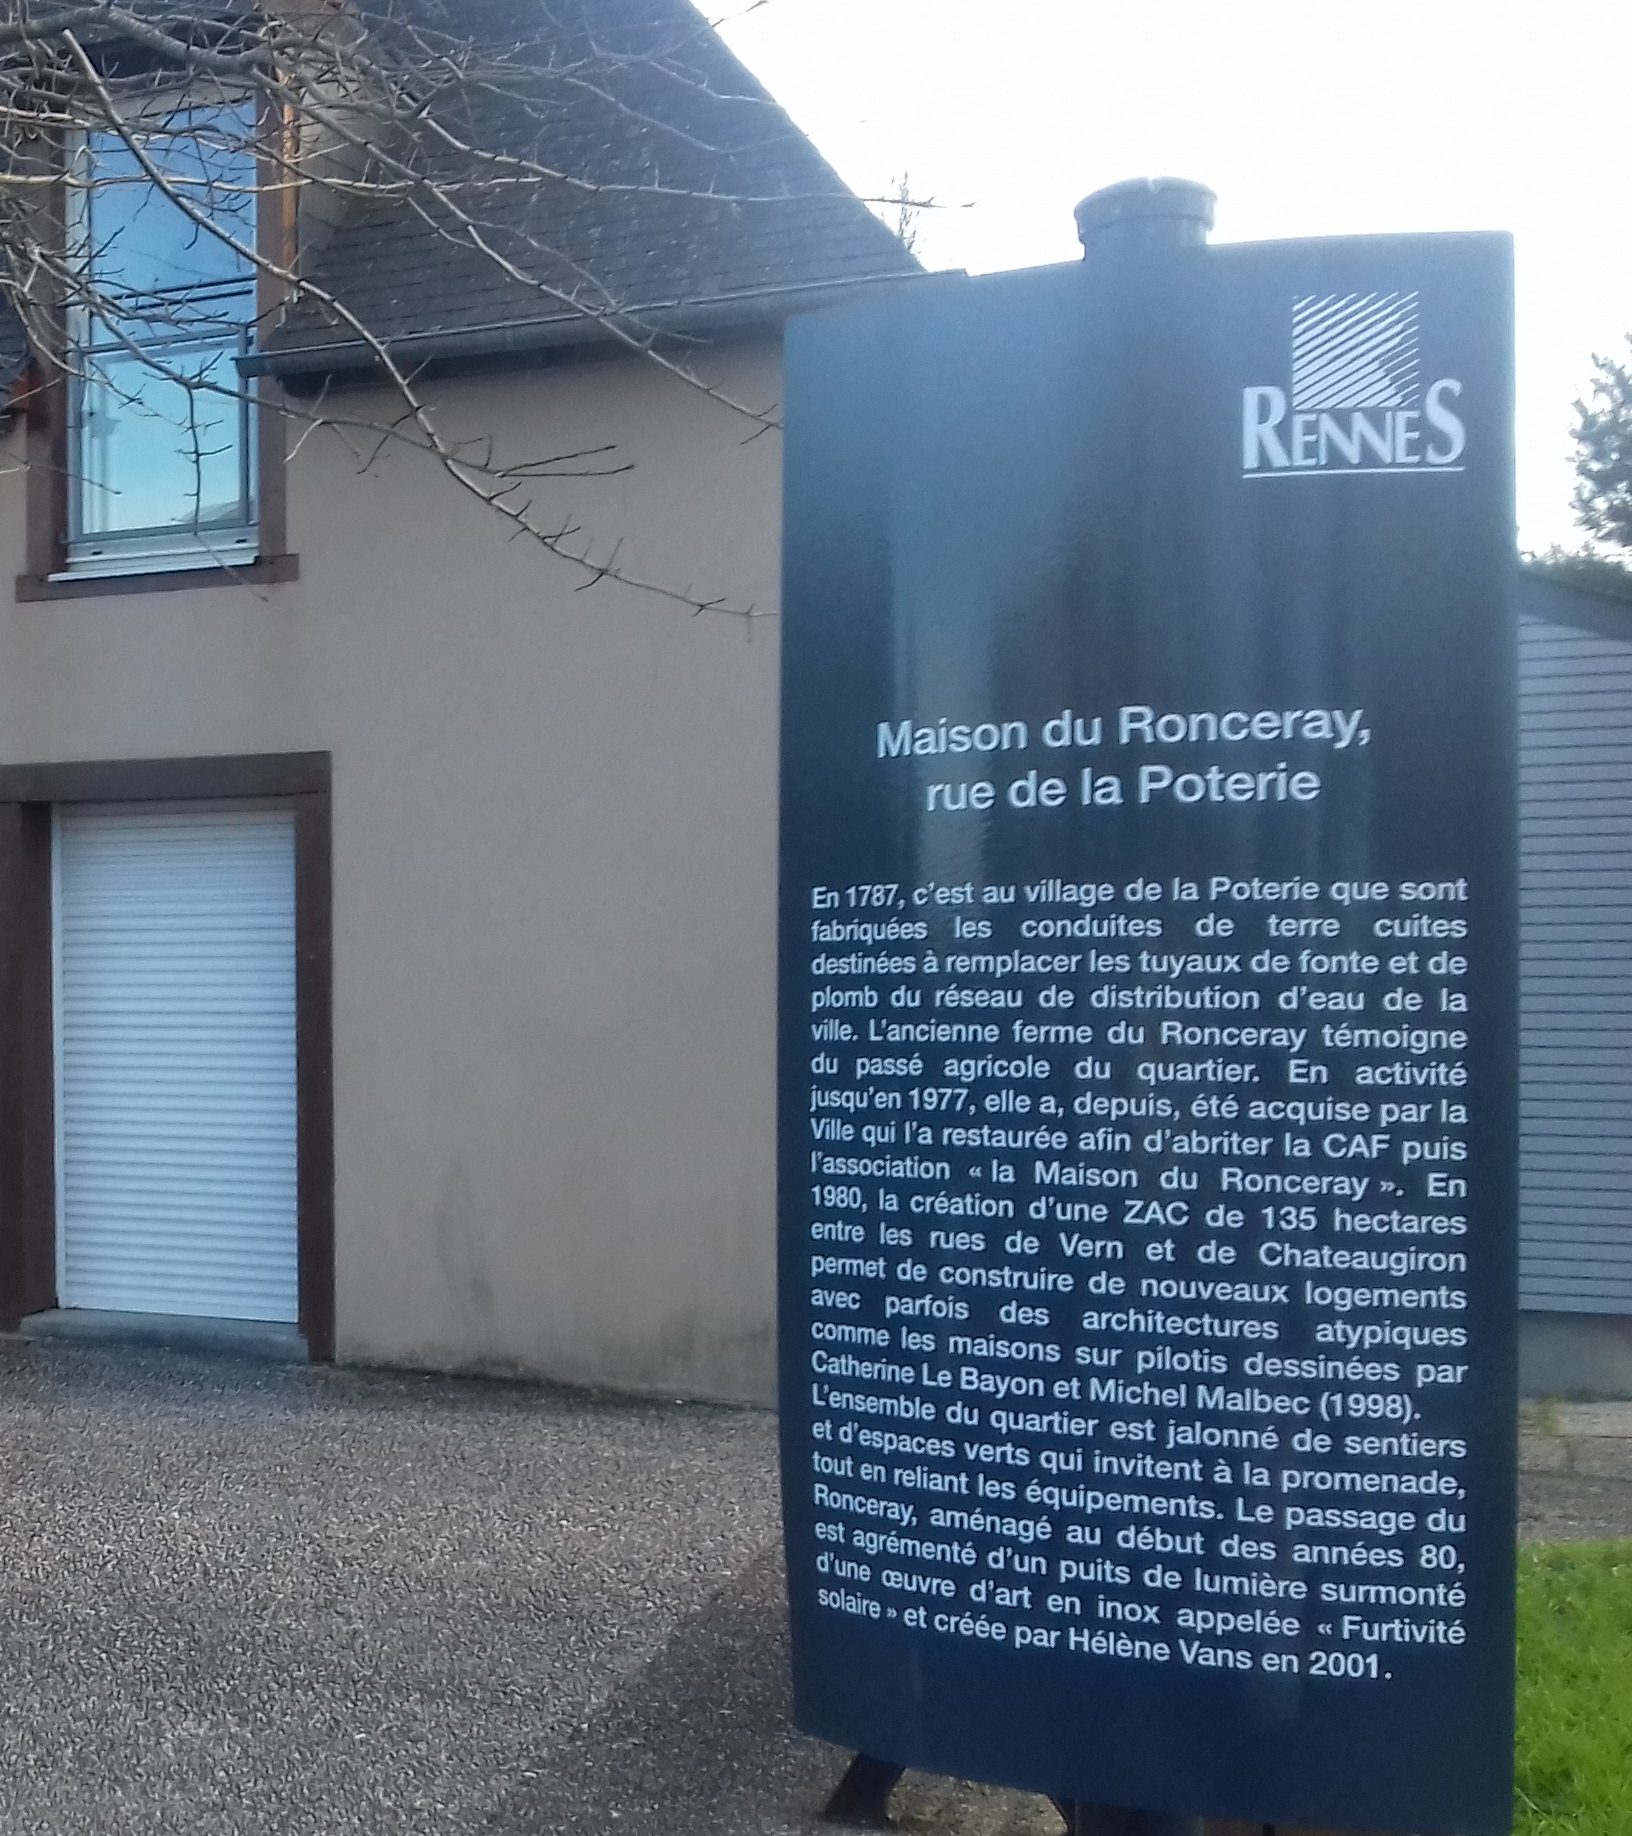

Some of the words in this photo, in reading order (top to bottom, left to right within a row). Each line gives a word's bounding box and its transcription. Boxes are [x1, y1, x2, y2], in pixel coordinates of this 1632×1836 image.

[1242, 379, 1466, 470] RENNES
[878, 718, 1027, 758] Maison
[1042, 709, 1101, 747] du
[1119, 706, 1370, 749] Ronceray,
[927, 782, 995, 811] rue
[1008, 770, 1067, 808] de
[1081, 768, 1124, 805] la
[1139, 762, 1321, 803] Poterie
[812, 886, 839, 909] En
[845, 884, 905, 909] 1787,
[913, 882, 974, 905] c'est
[982, 885, 1015, 904] au
[1023, 879, 1115, 907] village
[1124, 877, 1162, 902] de
[1172, 877, 1199, 901] la
[1209, 876, 1320, 901] Poterie
[1330, 882, 1389, 906] que
[1399, 878, 1468, 901] sont
[811, 917, 928, 945] fabriquées
[955, 916, 992, 938] les
[1020, 913, 1162, 938] conduites
[1195, 913, 1234, 937] de
[1267, 914, 1340, 937] terre
[1373, 913, 1468, 938] cuites
[811, 951, 916, 975] destinées
[923, 950, 939, 973] à
[945, 949, 1082, 978] remplacer
[1089, 949, 1131, 973] les
[1138, 950, 1242, 979] tuyaux
[1250, 949, 1291, 973] de
[1298, 949, 1380, 974] fonte
[1388, 951, 1419, 974] et
[1427, 951, 1468, 975] de
[811, 985, 878, 1012] plomb
[890, 985, 921, 1007] du
[935, 984, 1022, 1008] réseau
[1038, 984, 1074, 1008] de
[1090, 984, 1259, 1009] distribution
[1278, 986, 1364, 1010] d'eau
[1382, 987, 1423, 1011] de
[1440, 987, 1468, 1012] la
[811, 1019, 858, 1041] ville.
[869, 1018, 1000, 1042] L'ancienne
[1012, 1019, 1092, 1044] ferme
[1107, 1021, 1144, 1044] du
[1161, 1021, 1307, 1053] Ronceray
[1321, 1023, 1468, 1054] témoigne
[811, 1051, 838, 1074] du
[856, 1052, 923, 1080] passé
[944, 1054, 1050, 1082] agricole
[1074, 1056, 1110, 1079] du
[1137, 1058, 1259, 1086] quartier.
[1288, 1059, 1328, 1083] En
[1355, 1061, 1467, 1086] activité
[810, 1084, 901, 1113] jusqu'en
[909, 1087, 975, 1115] 1977,
[984, 1089, 1031, 1113] elle
[1039, 1096, 1064, 1118] a,
[1073, 1091, 1180, 1121] depuis,
[1191, 1093, 1239, 1119] été
[1248, 1096, 1371, 1126] acquise
[1380, 1103, 1432, 1127] par
[1441, 1099, 1469, 1123] la
[811, 1118, 855, 1141] Ville
[862, 1121, 896, 1147] qui
[905, 1121, 933, 1145] l'a
[942, 1125, 1068, 1150] restaurée
[1079, 1127, 1131, 1152] afin
[1143, 1129, 1273, 1156] d'abriter
[1285, 1132, 1312, 1157] la
[1323, 1133, 1390, 1158] CAF
[1402, 1136, 1467, 1166] puis
[811, 1150, 950, 1180] l'association
[992, 1159, 1015, 1183] la
[1035, 1160, 1138, 1188] Maison
[1160, 1165, 1198, 1190] du
[1221, 1167, 1369, 1201] Ronceray
[1427, 1173, 1466, 1198] En
[811, 1184, 867, 1213] 1980,
[879, 1188, 899, 1211] la
[910, 1191, 1014, 1218] création
[1029, 1196, 1109, 1222] d'une
[1123, 1200, 1189, 1226] ZAC
[1205, 1204, 1245, 1228] de
[1261, 1206, 1317, 1231] 135
[1334, 1207, 1467, 1235] hectares
[811, 1220, 865, 1243] entre
[880, 1222, 912, 1246] les
[930, 1231, 985, 1251] rues
[1005, 1230, 1040, 1254] de
[1059, 1232, 1123, 1259] Vern
[1146, 1239, 1175, 1261] et
[1197, 1239, 1236, 1264] de
[1259, 1242, 1466, 1276] Chateaugiron
[811, 1256, 887, 1279] permet
[897, 1258, 927, 1282] de
[939, 1266, 1074, 1292] construire
[1088, 1271, 1126, 1295] de
[1141, 1278, 1289, 1303] nouveaux
[1305, 1280, 1467, 1311] logements
[811, 1289, 861, 1310] avec
[885, 1294, 969, 1320] parfois
[999, 1300, 1050, 1326] des
[1082, 1308, 1279, 1340] architectures
[1315, 1319, 1467, 1350] atypiques
[811, 1322, 891, 1346] comme
[901, 1326, 935, 1351] les
[949, 1334, 1061, 1362] maisons
[1075, 1346, 1123, 1366] sur
[1137, 1345, 1228, 1374] pilotis
[1243, 1352, 1400, 1381] dessinées
[1416, 1364, 1469, 1388] par
[811, 1350, 915, 1384] Catherine
[922, 1362, 952, 1388] Le
[960, 1366, 1044, 1399] Bayon
[1053, 1377, 1081, 1400] et
[1090, 1377, 1186, 1407] Michel
[1197, 1385, 1310, 1415] Malbec
[1320, 1392, 1421, 1425] (1998).
[812, 1383, 936, 1421] L'ensemble
[946, 1401, 978, 1425] du
[990, 1410, 1099, 1436] quartier
[1110, 1419, 1156, 1441] est
[1166, 1419, 1279, 1450] jalonné
[1291, 1428, 1332, 1453] de
[1344, 1432, 1467, 1458] sentiers
[812, 1419, 833, 1440] et
[839, 1421, 955, 1458] d'espaces
[964, 1442, 1030, 1466] verts
[1039, 1448, 1082, 1474] qui
[1094, 1450, 1203, 1482] invitent
[1213, 1458, 1233, 1484] à
[1243, 1461, 1271, 1486] la
[1281, 1470, 1466, 1500] promenade,
[814, 1483, 917, 1526] Ronceray,
[930, 1508, 1052, 1544] aménagé
[1066, 1525, 1101, 1545] au
[1116, 1524, 1205, 1555] début
[1219, 1534, 1277, 1560] des
[1292, 1541, 1404, 1567] années
[1419, 1545, 1465, 1574] 80,
[818, 1588, 881, 1619] solaire
[903, 1606, 927, 1628] et
[934, 1611, 1006, 1641] créée
[1014, 1625, 1061, 1649] par
[1069, 1627, 1170, 1661] Hélène
[1178, 1639, 1253, 1669] Vans
[1261, 1653, 1299, 1673] en
[1309, 1651, 1392, 1680] 2001.
